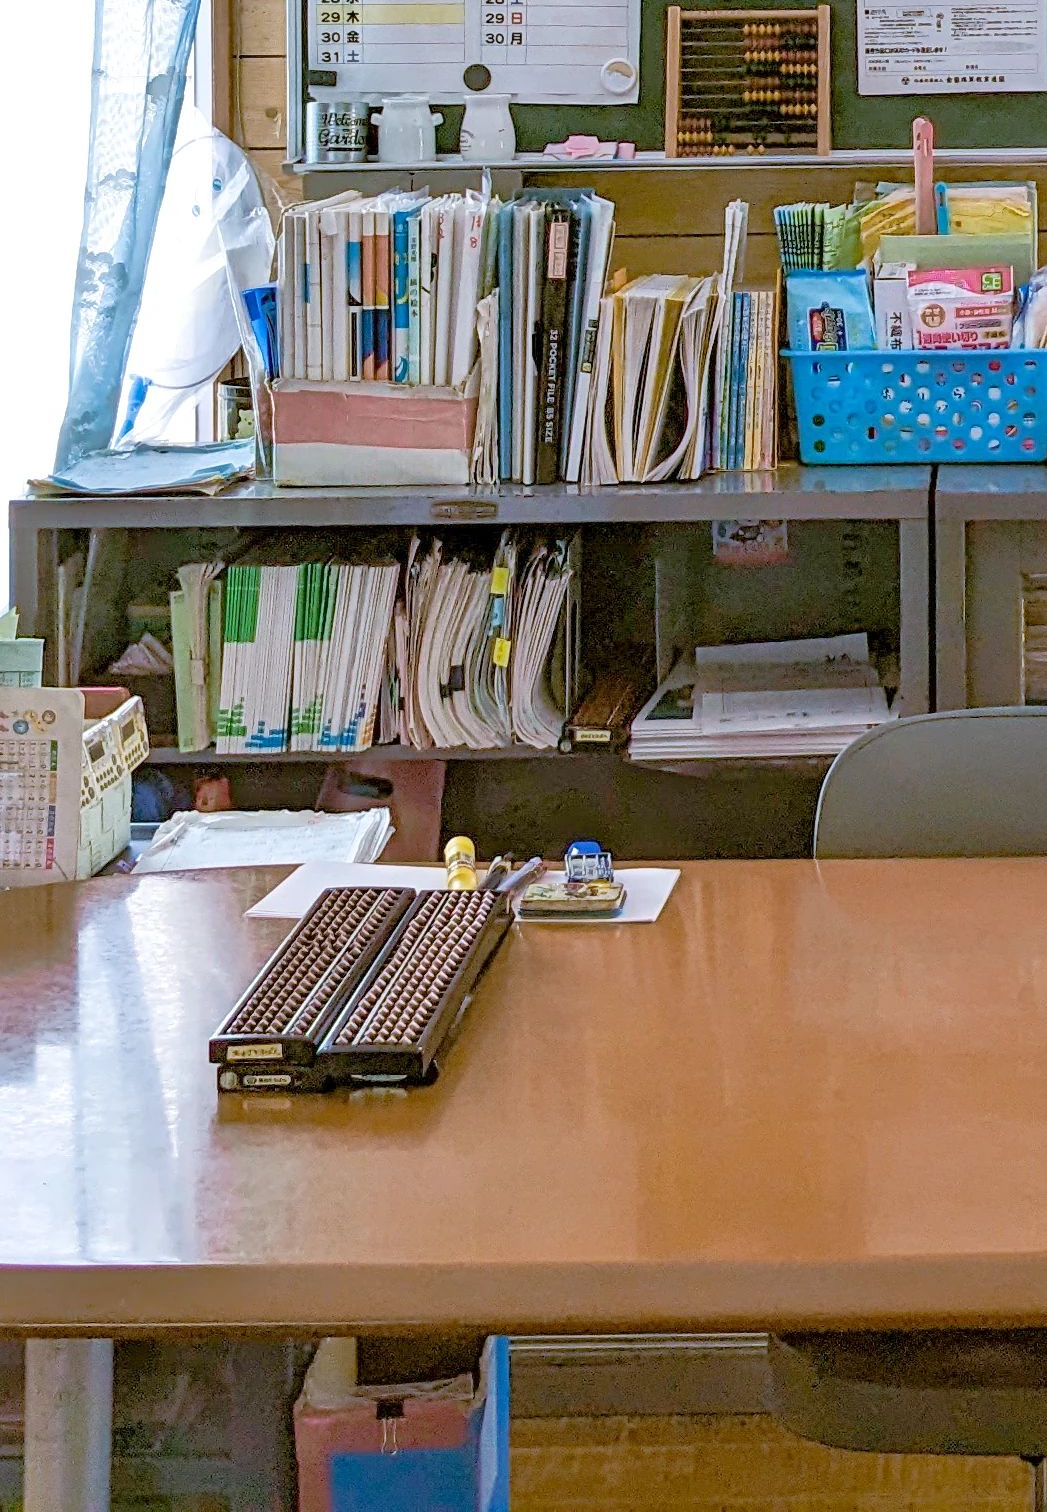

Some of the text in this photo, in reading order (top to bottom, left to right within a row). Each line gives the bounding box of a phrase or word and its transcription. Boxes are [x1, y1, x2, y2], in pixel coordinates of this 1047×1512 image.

[322, 11, 359, 23] 29 木
[486, 32, 522, 45] 30 月
[320, 50, 358, 64] 31 土
[545, 330, 558, 444] 32 POCKET FILE B5 SIZE
